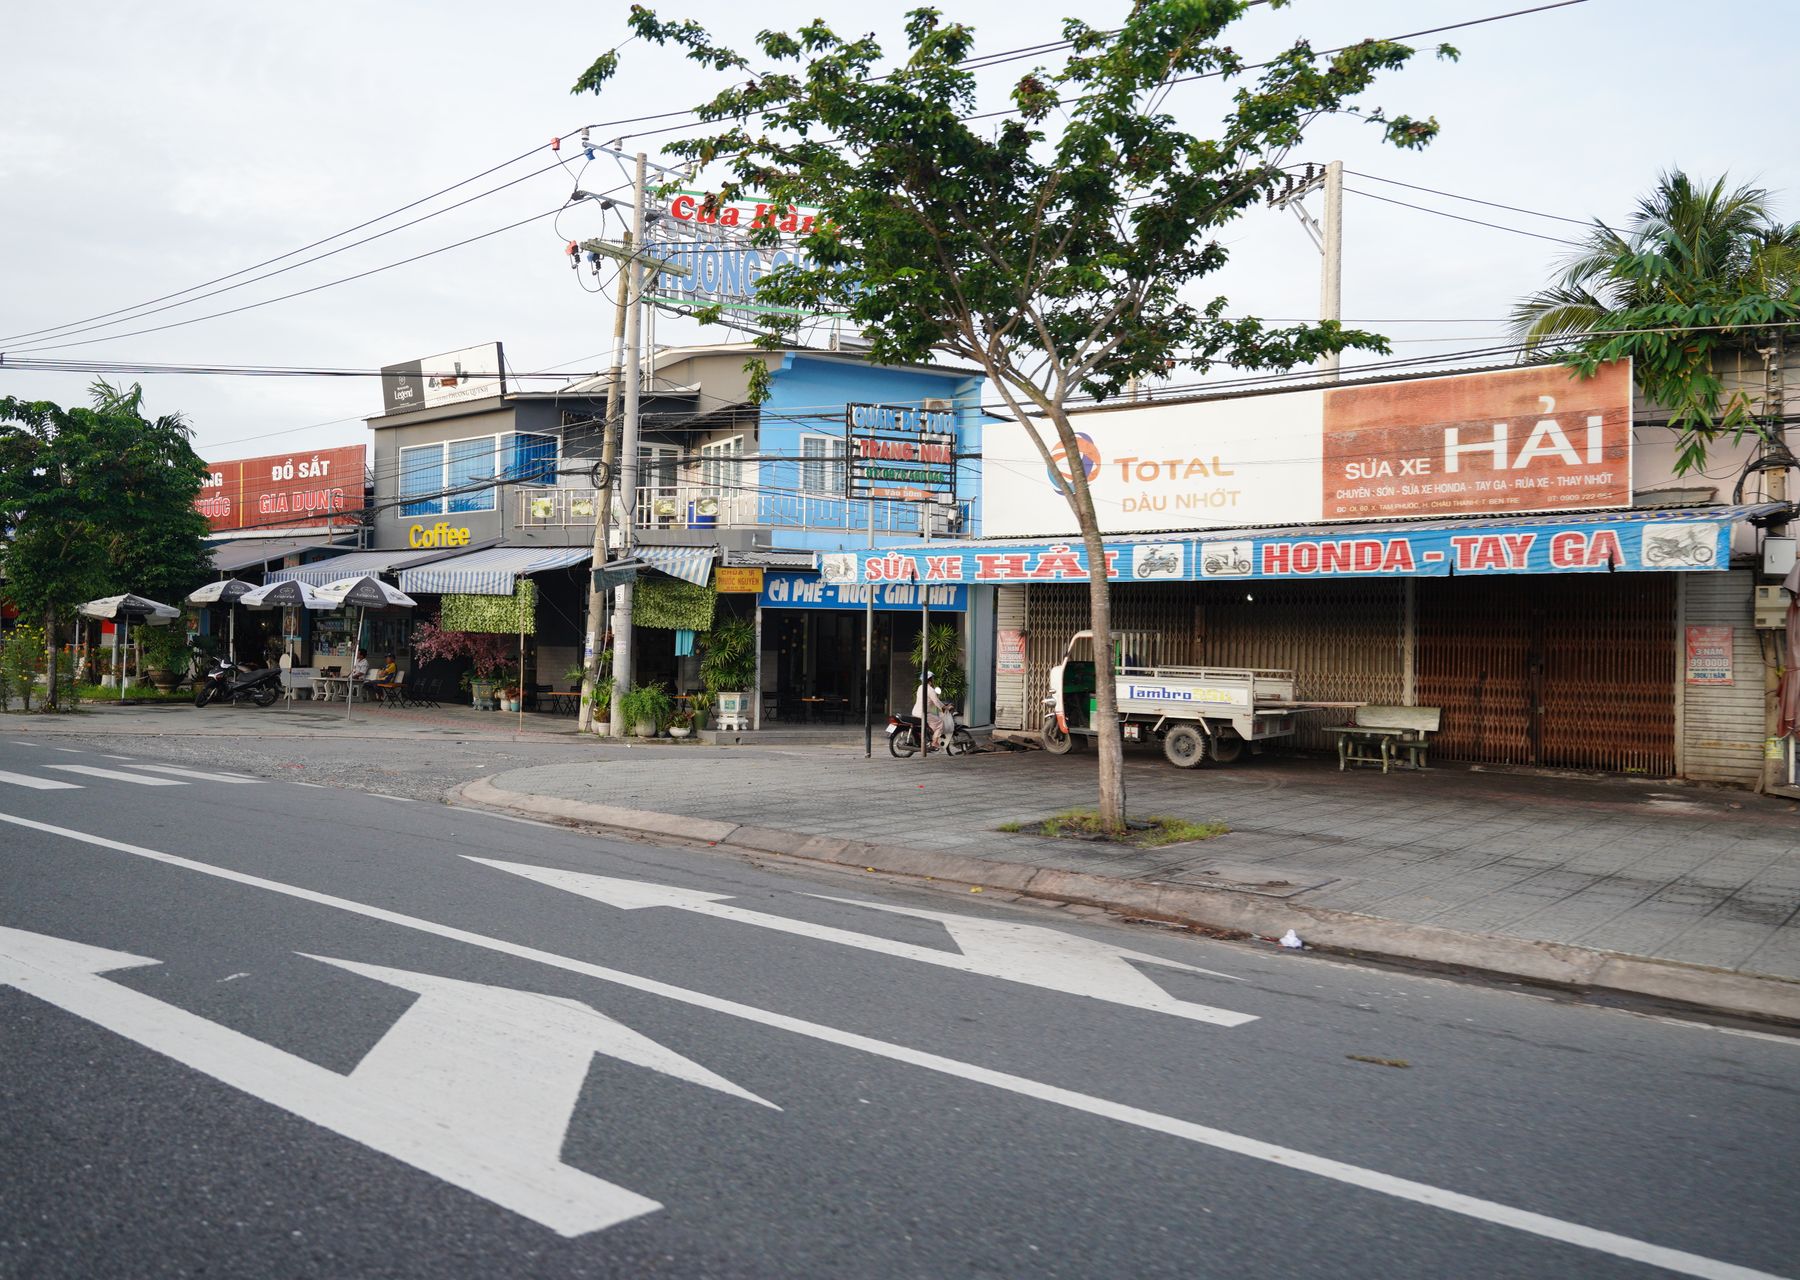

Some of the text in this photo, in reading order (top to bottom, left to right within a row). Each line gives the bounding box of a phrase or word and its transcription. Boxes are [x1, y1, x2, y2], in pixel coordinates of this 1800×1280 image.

[394, 388, 413, 400] Legend
[860, 440, 914, 459] TRANG
[1345, 396, 1603, 480] SỬA XE HẢI
[272, 455, 330, 481] ĐỒ SẮT
[1421, 484, 1433, 495] XE
[1434, 482, 1466, 494] HONDA
[1475, 480, 1492, 491] TAY
[1493, 479, 1507, 490] GA
[1537, 477, 1549, 487] XE
[1557, 475, 1581, 487] THAY
[259, 488, 344, 517] GIA DỤNG
[1122, 488, 1241, 513] DẦU NHỚT
[409, 521, 471, 548] Coffee
[866, 547, 1118, 580] SỬA XE HẢI
[1263, 540, 1414, 574] HONDA
[1452, 534, 1535, 570] TAY
[1551, 530, 1624, 569] GA
[1129, 686, 1192, 699] Lambro
